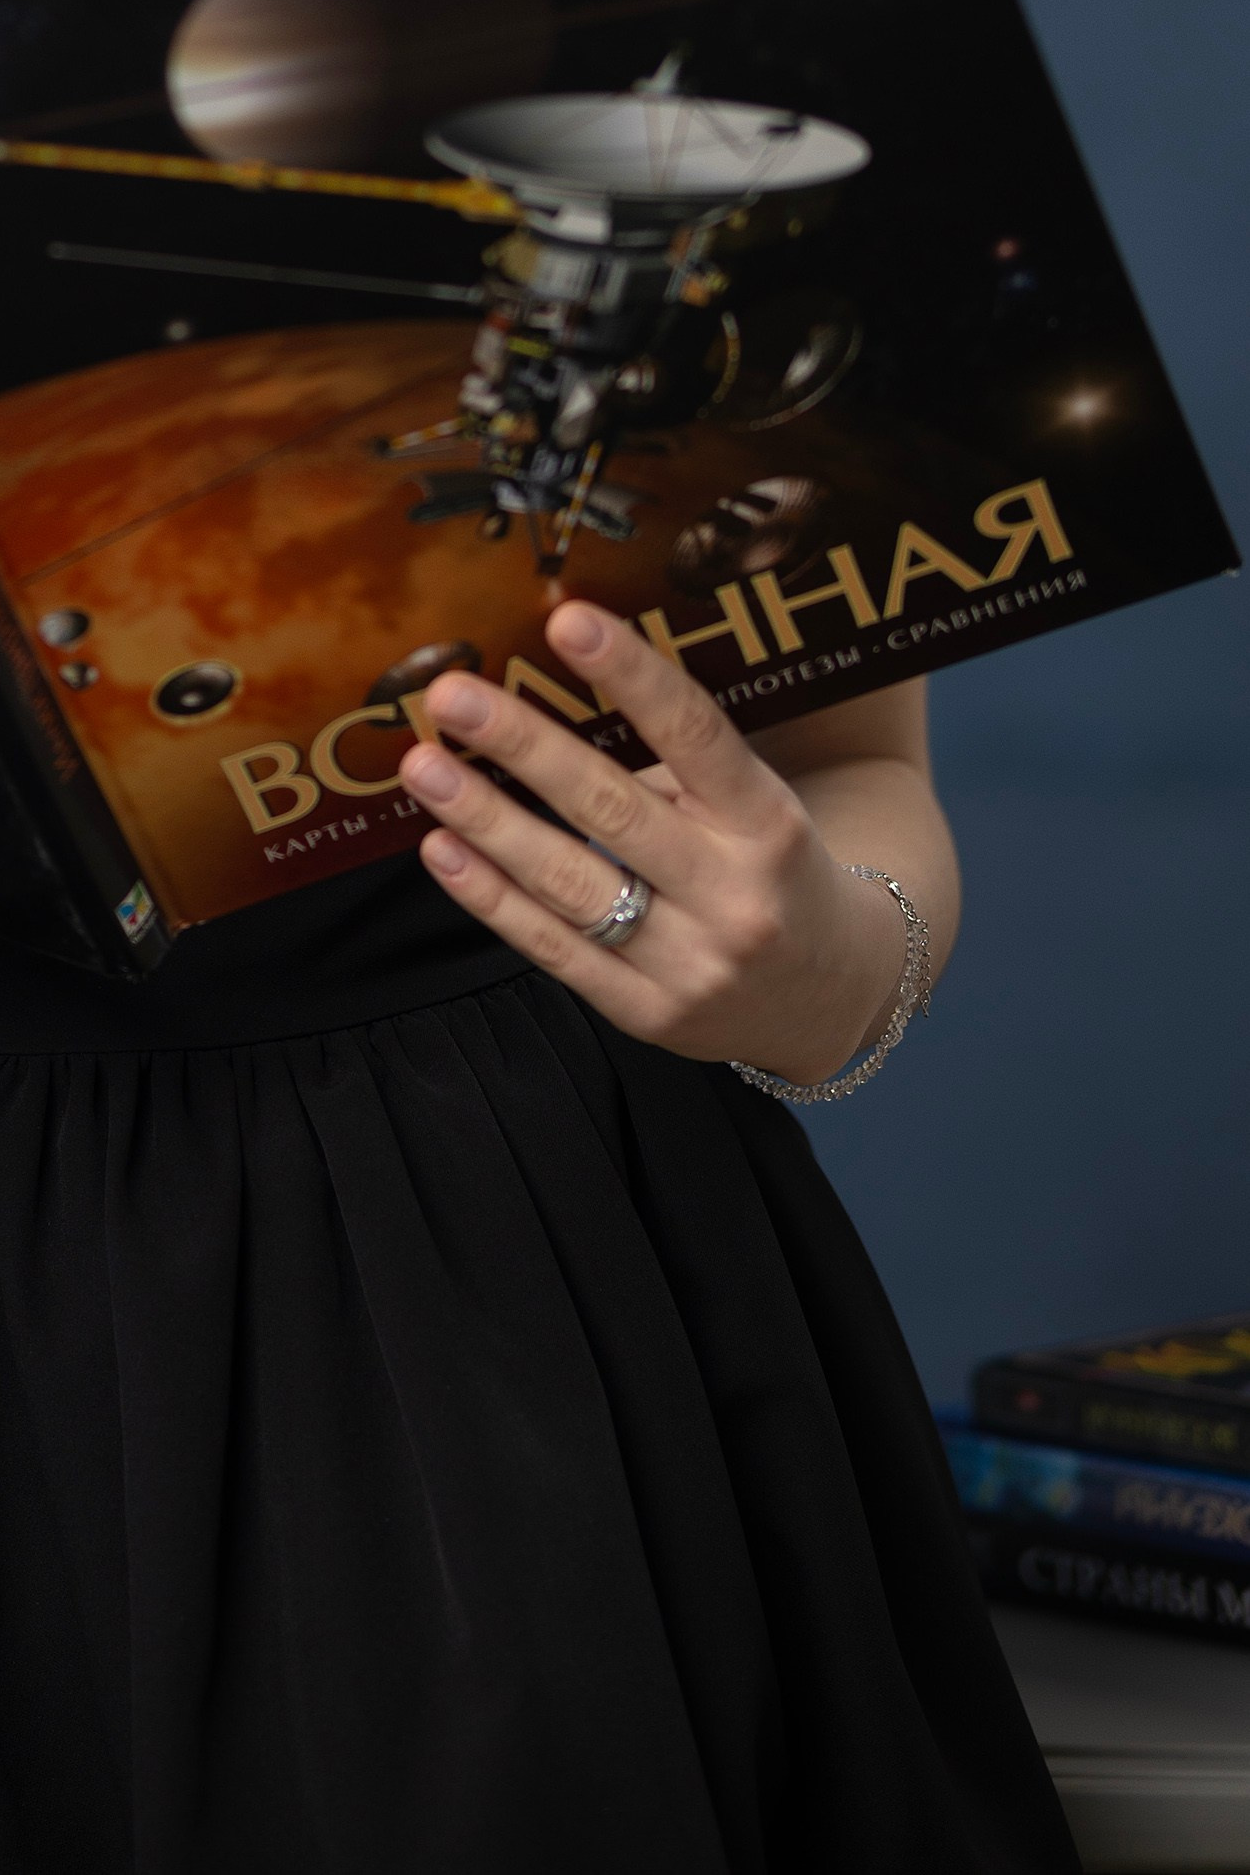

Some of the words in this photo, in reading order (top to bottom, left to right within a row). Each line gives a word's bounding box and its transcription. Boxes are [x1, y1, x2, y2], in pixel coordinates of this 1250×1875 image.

[886, 568, 1088, 652] СРАВНЕНИЯ
[220, 477, 1075, 835] ВСЛННАЯ
[262, 814, 369, 864] КАРТЫ
